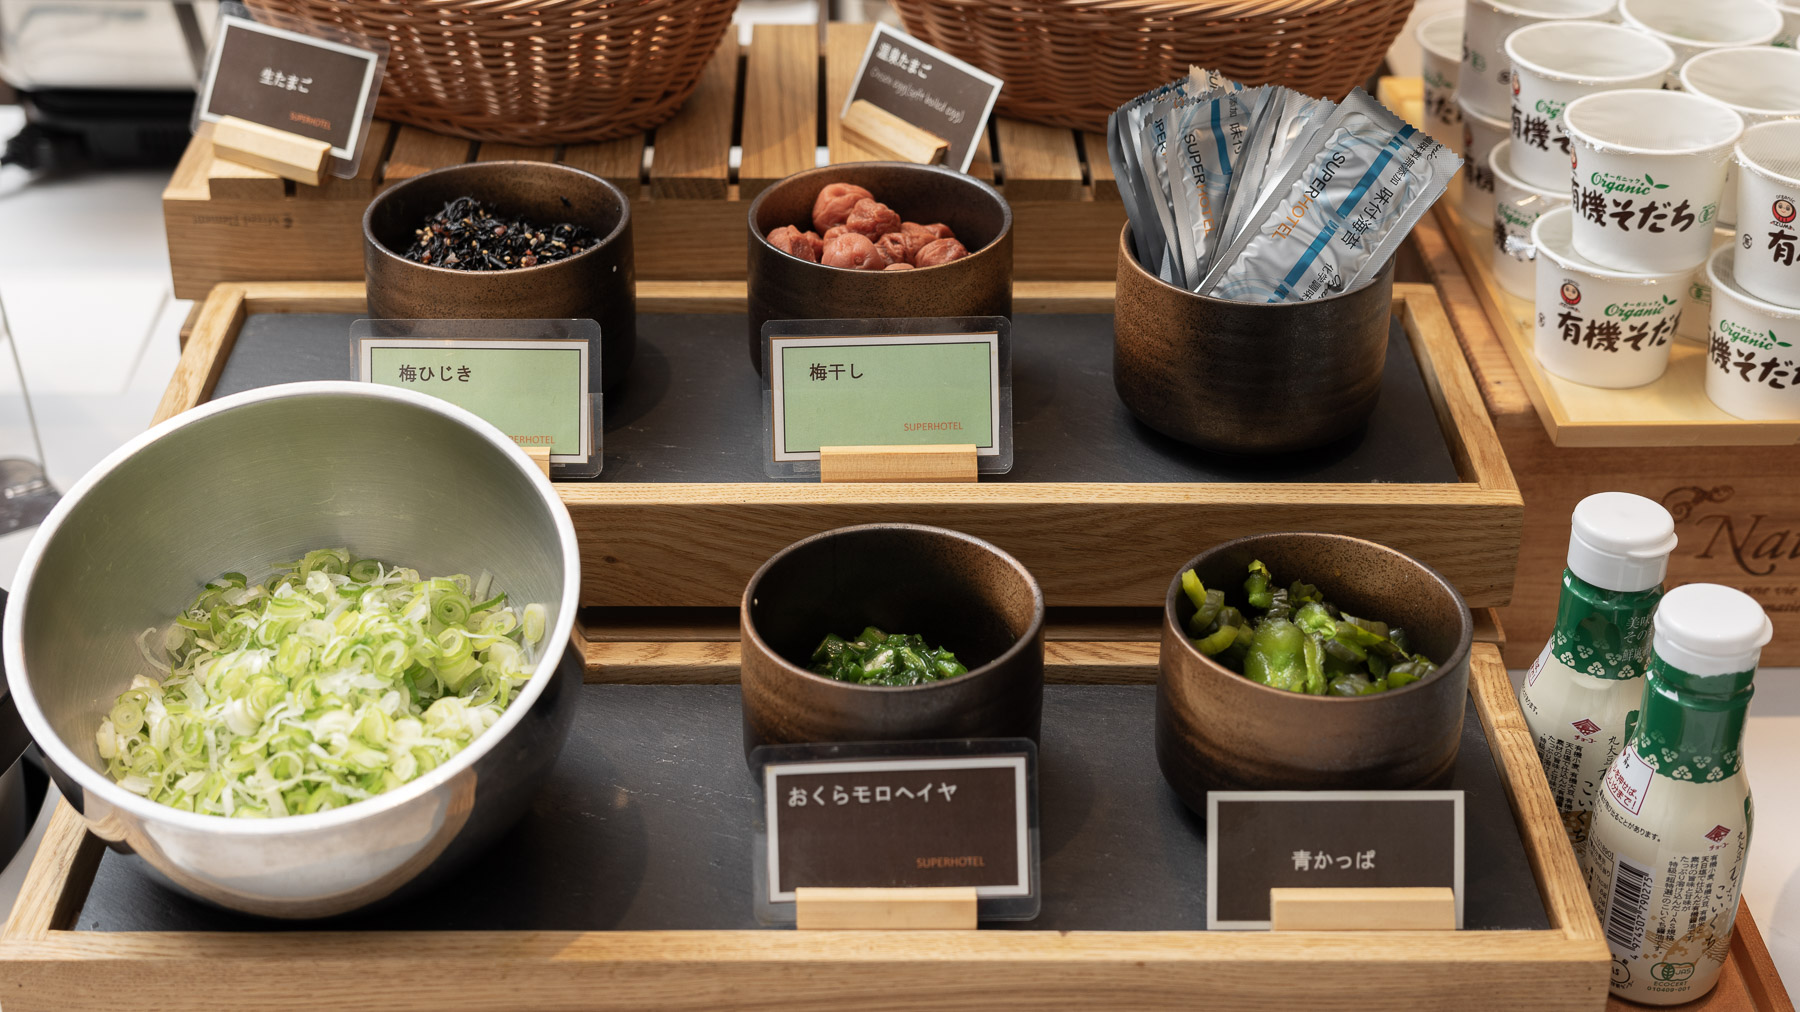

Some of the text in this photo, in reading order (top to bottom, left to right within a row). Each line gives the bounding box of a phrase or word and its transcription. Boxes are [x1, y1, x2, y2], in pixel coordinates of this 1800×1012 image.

[258, 67, 313, 93] 生たまご
[289, 111, 332, 131] SUPERHOTEL
[1184, 132, 1216, 239] SUPERHOTEL
[1590, 171, 1652, 196] Organic
[1271, 151, 1347, 240] SUPERHOTEL
[1570, 177, 1696, 234] 有機そだち
[1341, 186, 1395, 250] 味付海苔
[1604, 302, 1665, 322] Organic
[1720, 319, 1774, 351] Organic
[399, 364, 472, 383] 梅ひじき
[809, 363, 864, 381] 梅干し
[903, 421, 964, 432] SUPERHOTEL
[788, 782, 957, 807] おくらモロヘイヤ
[915, 856, 986, 870] SUPERHOTEL
[1291, 850, 1377, 871] 青かっぱ
[1653, 980, 1689, 988] ECOCERT
